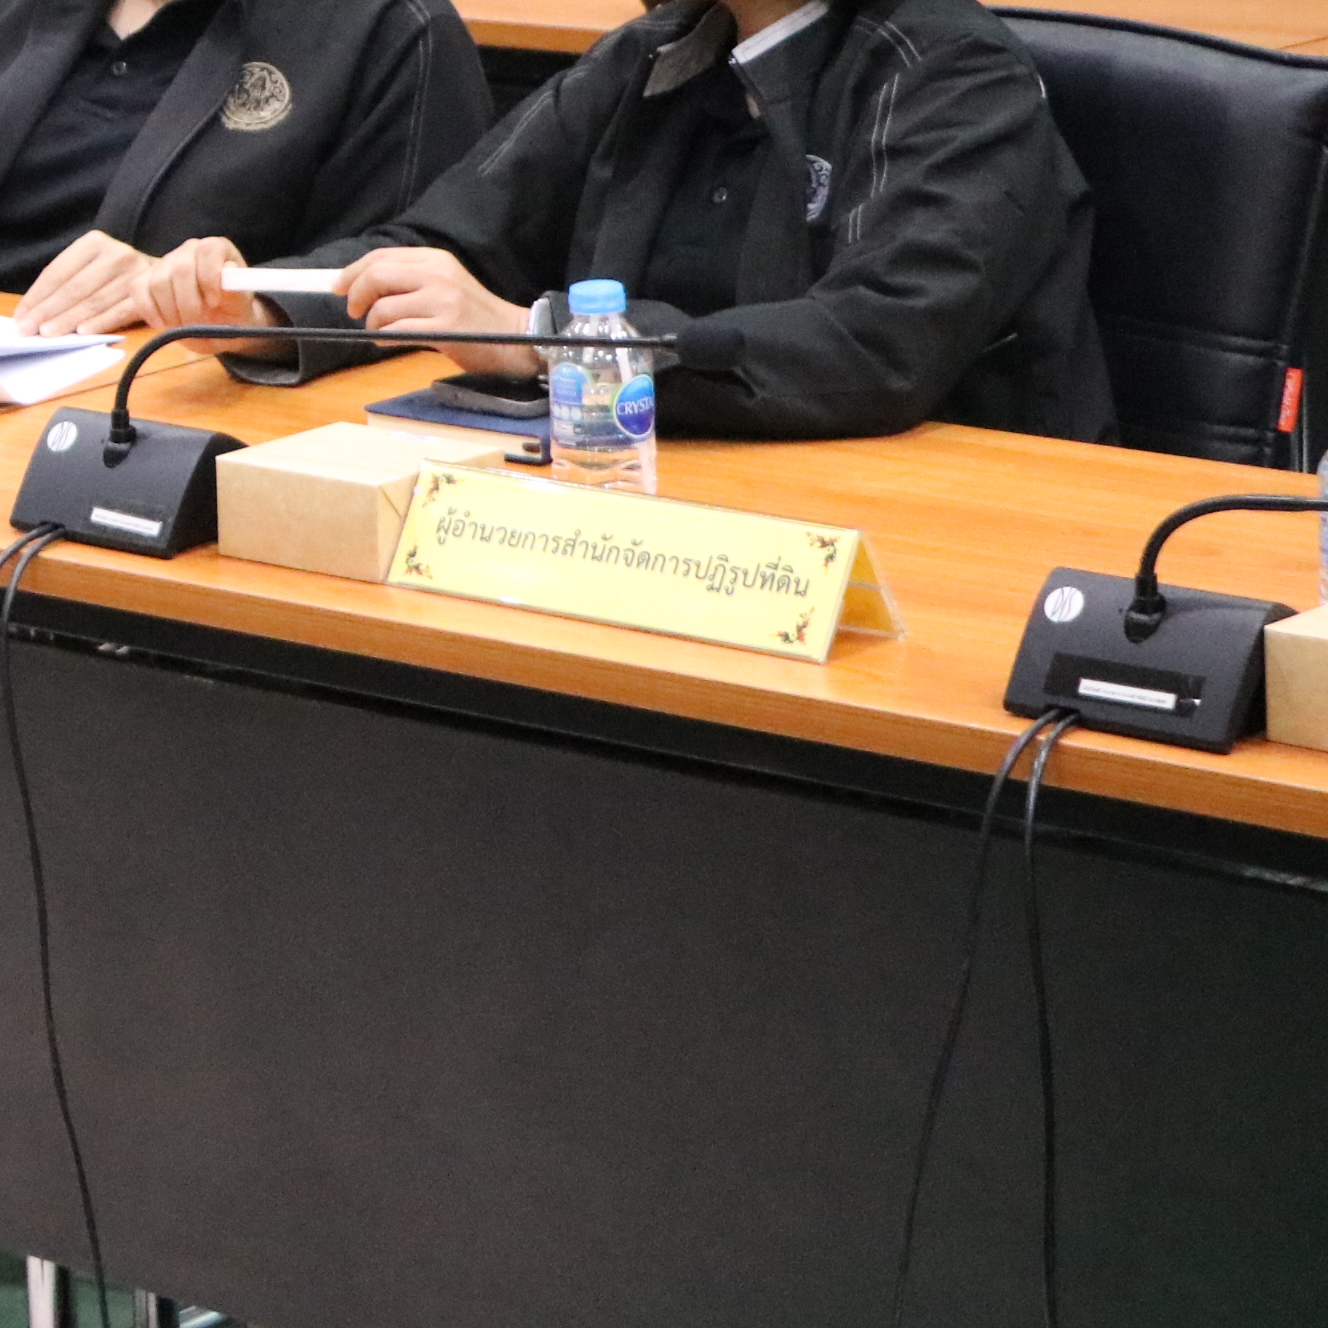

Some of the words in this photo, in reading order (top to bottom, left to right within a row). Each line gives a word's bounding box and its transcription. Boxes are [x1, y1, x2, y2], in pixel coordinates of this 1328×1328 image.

[435, 506, 810, 598] ผู้อำนวยการสำนักจัดการปฏิรูปที่ดิน
